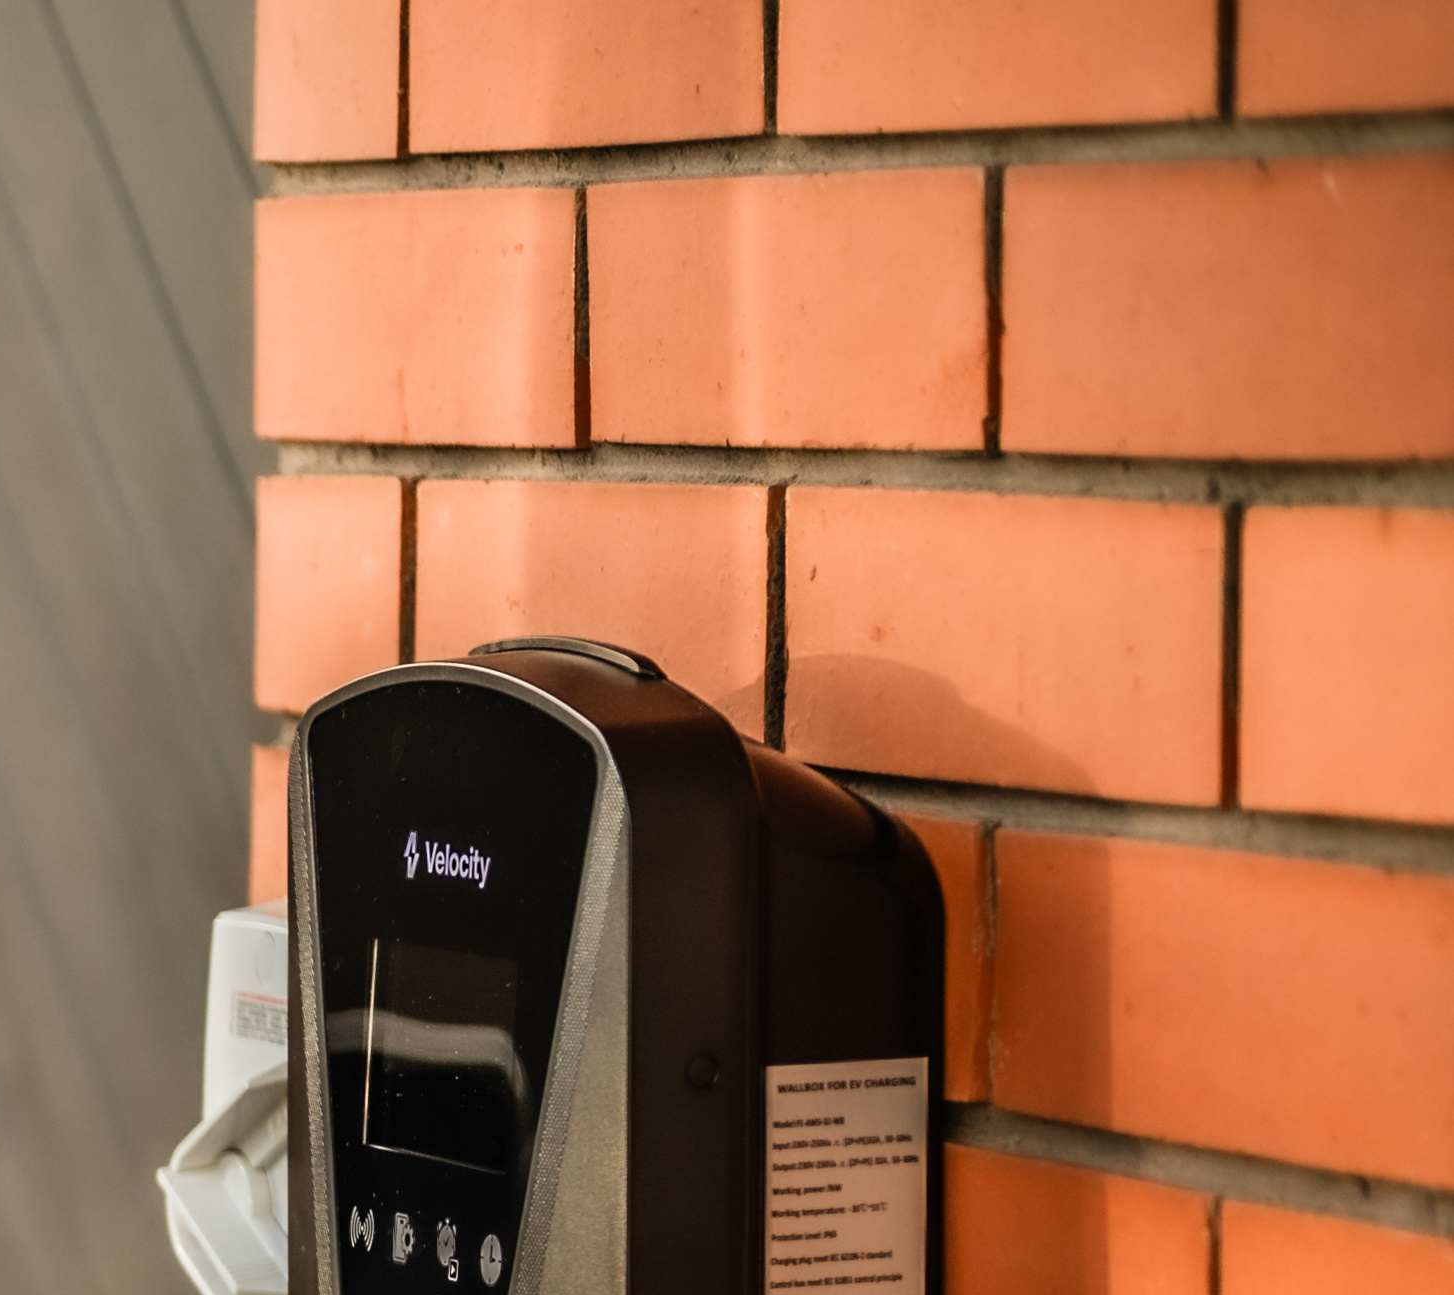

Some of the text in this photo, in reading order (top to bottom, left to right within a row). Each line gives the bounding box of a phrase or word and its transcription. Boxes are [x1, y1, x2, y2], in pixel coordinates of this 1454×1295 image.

[424, 840, 491, 889] Velocity
[777, 1076, 916, 1094] WALLBOX FOR EV CHARGING
